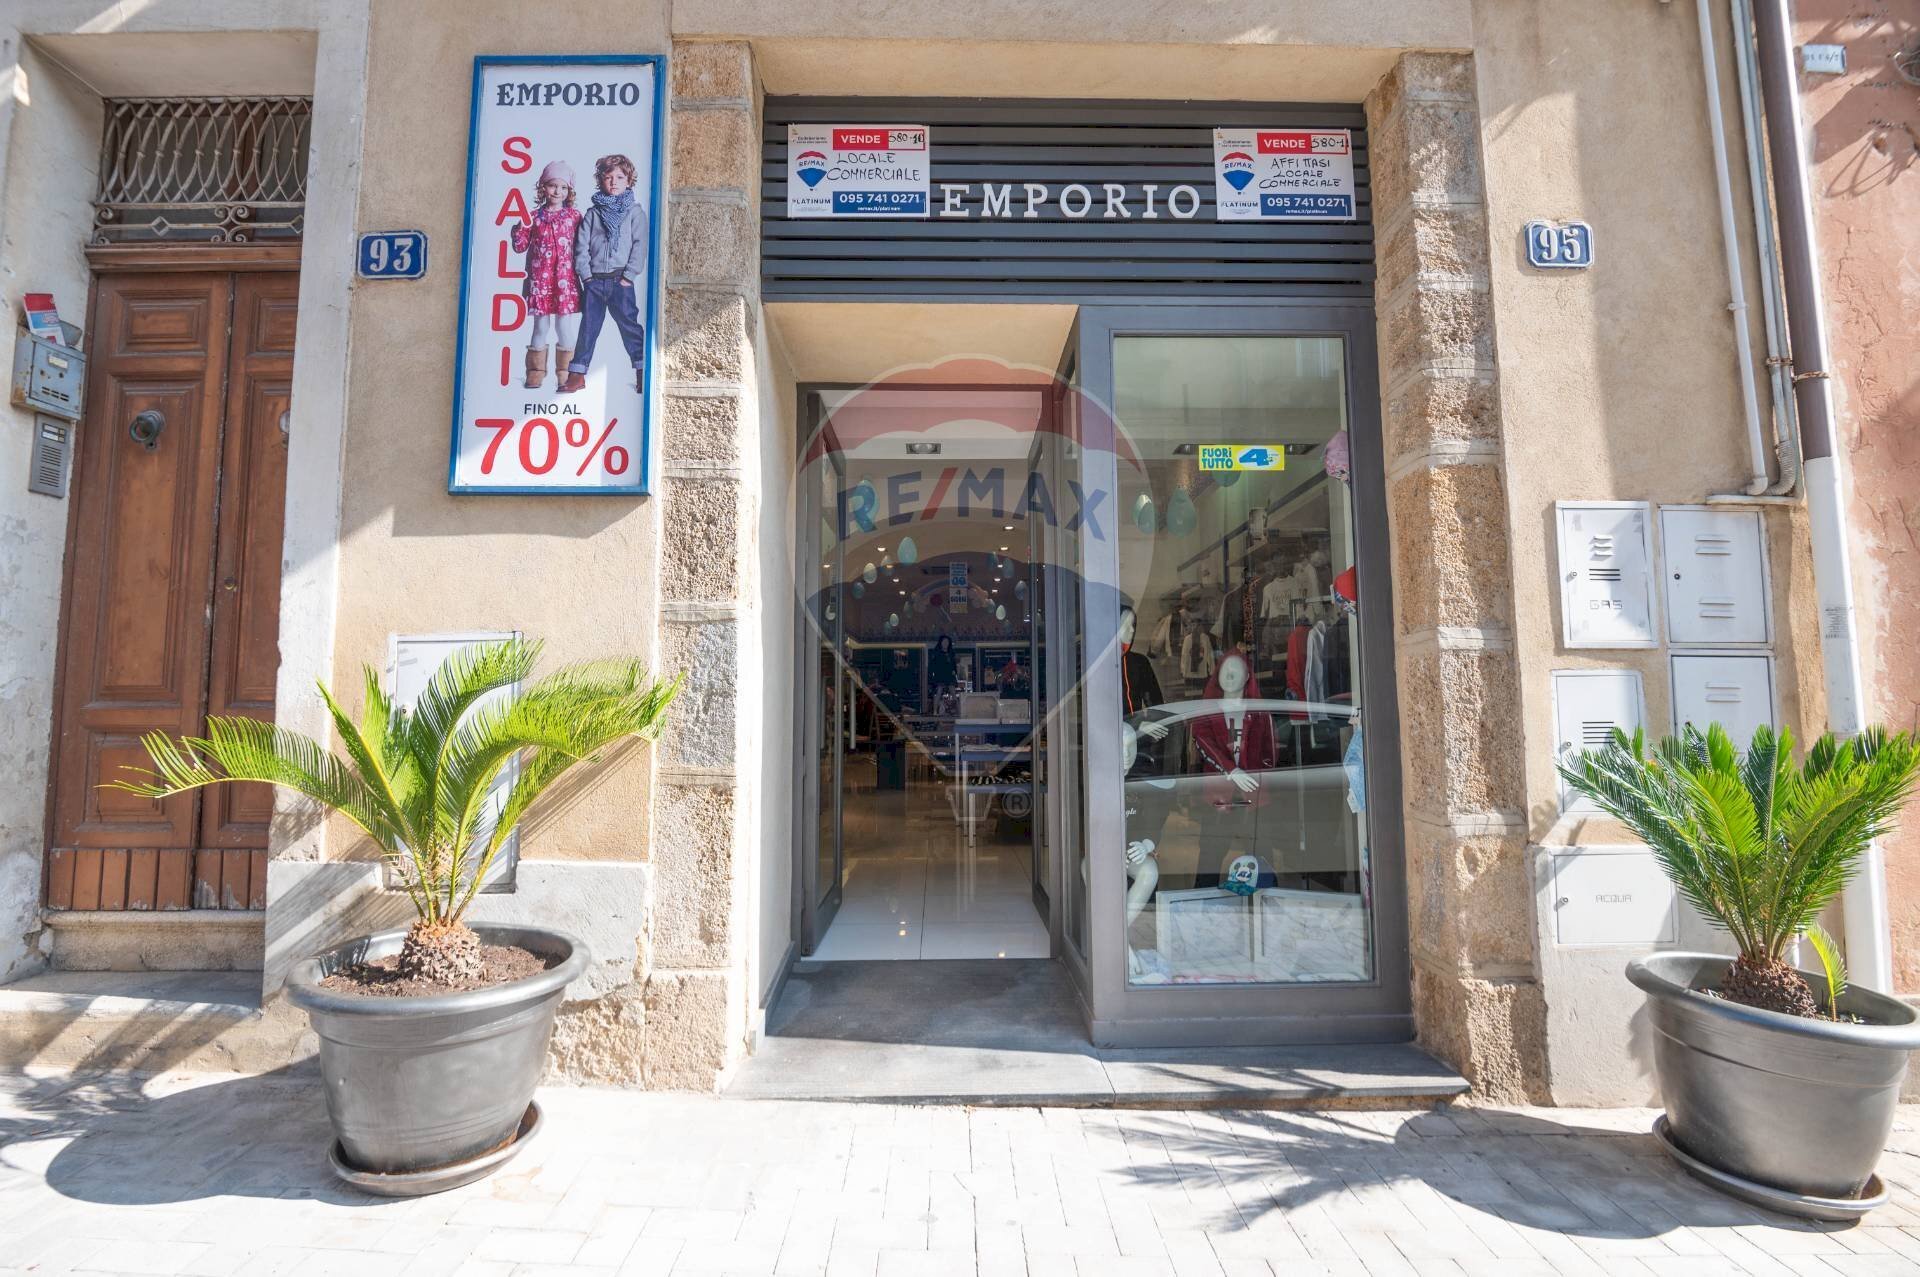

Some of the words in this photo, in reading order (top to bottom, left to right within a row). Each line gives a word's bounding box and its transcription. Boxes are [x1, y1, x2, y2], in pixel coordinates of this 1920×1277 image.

[496, 82, 640, 107] EMPORIO
[841, 135, 881, 144] VENDE
[1264, 139, 1306, 148] VENDE
[799, 159, 825, 167] RE/MAX
[837, 152, 896, 164] LOCALE
[826, 167, 921, 181] COMMERCIALE
[1273, 170, 1324, 178] LOCALE
[1258, 179, 1342, 189] COMMERCIALE
[840, 193, 864, 203] 095
[867, 193, 887, 203] 741
[891, 193, 920, 203] 0271
[939, 183, 1200, 219] EMPORIO
[1267, 197, 1291, 207] 095
[1294, 197, 1314, 207] 741
[1317, 198, 1345, 207] 0271
[1540, 228, 1580, 260] 95
[369, 237, 414, 272] 93
[491, 136, 533, 387] SALDI
[524, 403, 559, 415] FINO
[562, 403, 581, 415] AL
[475, 417, 629, 476] 70%
[1202, 457, 1233, 469] TUTTO
[1595, 894, 1632, 903] ACQUA
